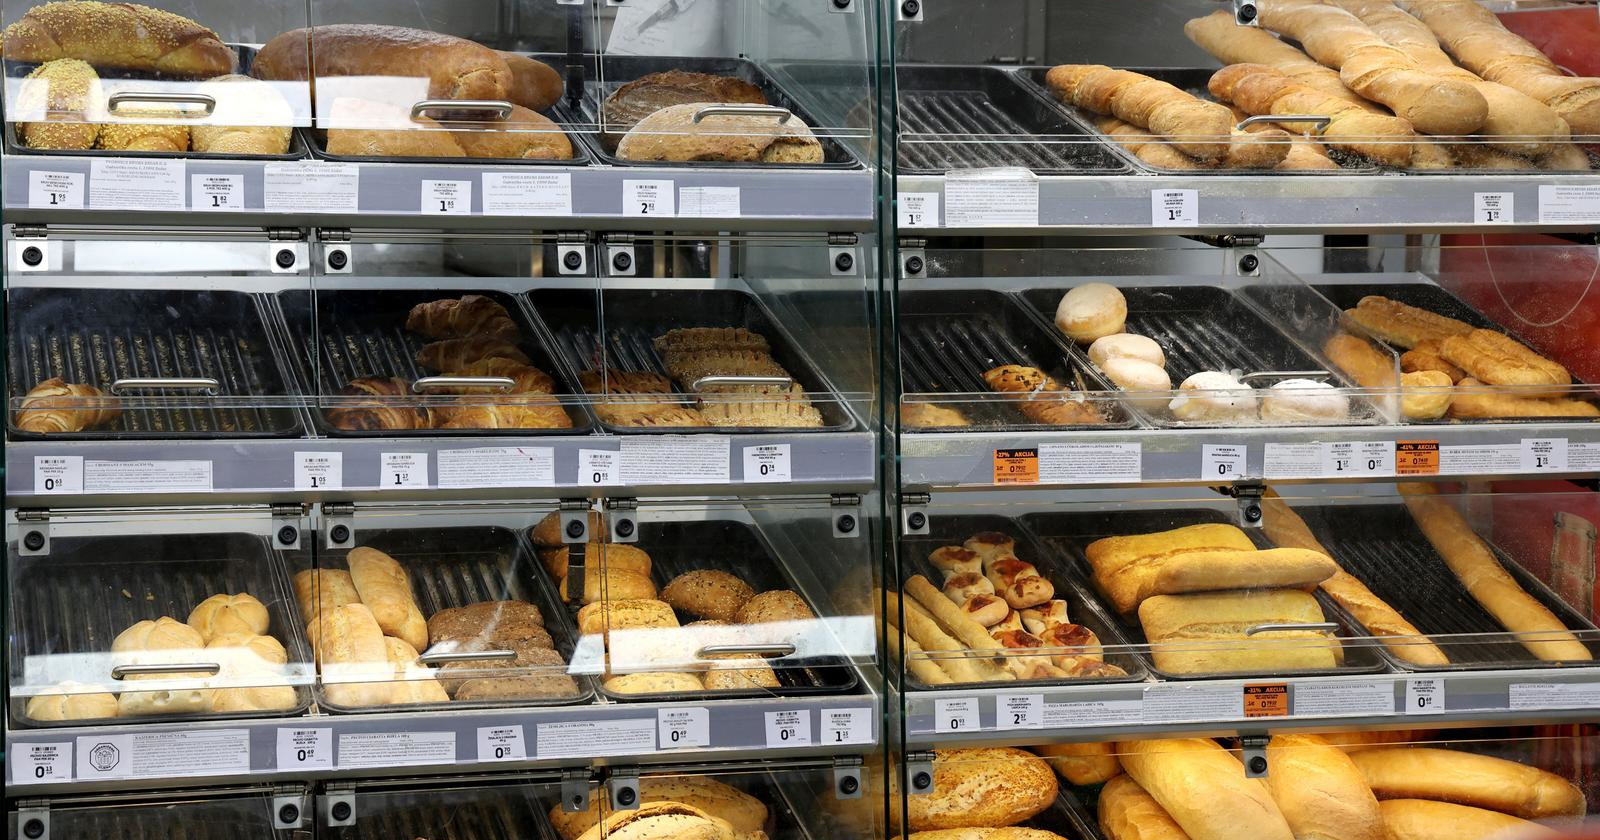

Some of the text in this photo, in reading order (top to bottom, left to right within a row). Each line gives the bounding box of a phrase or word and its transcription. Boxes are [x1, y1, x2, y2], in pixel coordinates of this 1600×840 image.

[50, 193, 58, 205] 1
[212, 195, 220, 207] 1
[440, 200, 447, 212] 1
[641, 202, 648, 214] 2
[908, 214, 915, 225] 1
[1168, 210, 1175, 221] 1
[1487, 211, 1494, 222] 1
[1336, 460, 1343, 471] 1
[1368, 459, 1375, 470] 0
[1536, 457, 1543, 467] 1
[760, 464, 768, 475] 0
[1218, 463, 1226, 475] 0
[311, 476, 319, 488] 1
[394, 473, 402, 485] 1
[593, 472, 601, 483] 0
[45, 478, 54, 490] 0
[1418, 696, 1426, 708] 0
[951, 718, 958, 730] 0
[1013, 713, 1020, 725] 2
[671, 730, 679, 742] 0
[780, 729, 789, 741] 0
[835, 731, 842, 742] 1
[297, 749, 306, 761] 0
[495, 747, 503, 759] 0
[35, 765, 45, 778] 0
